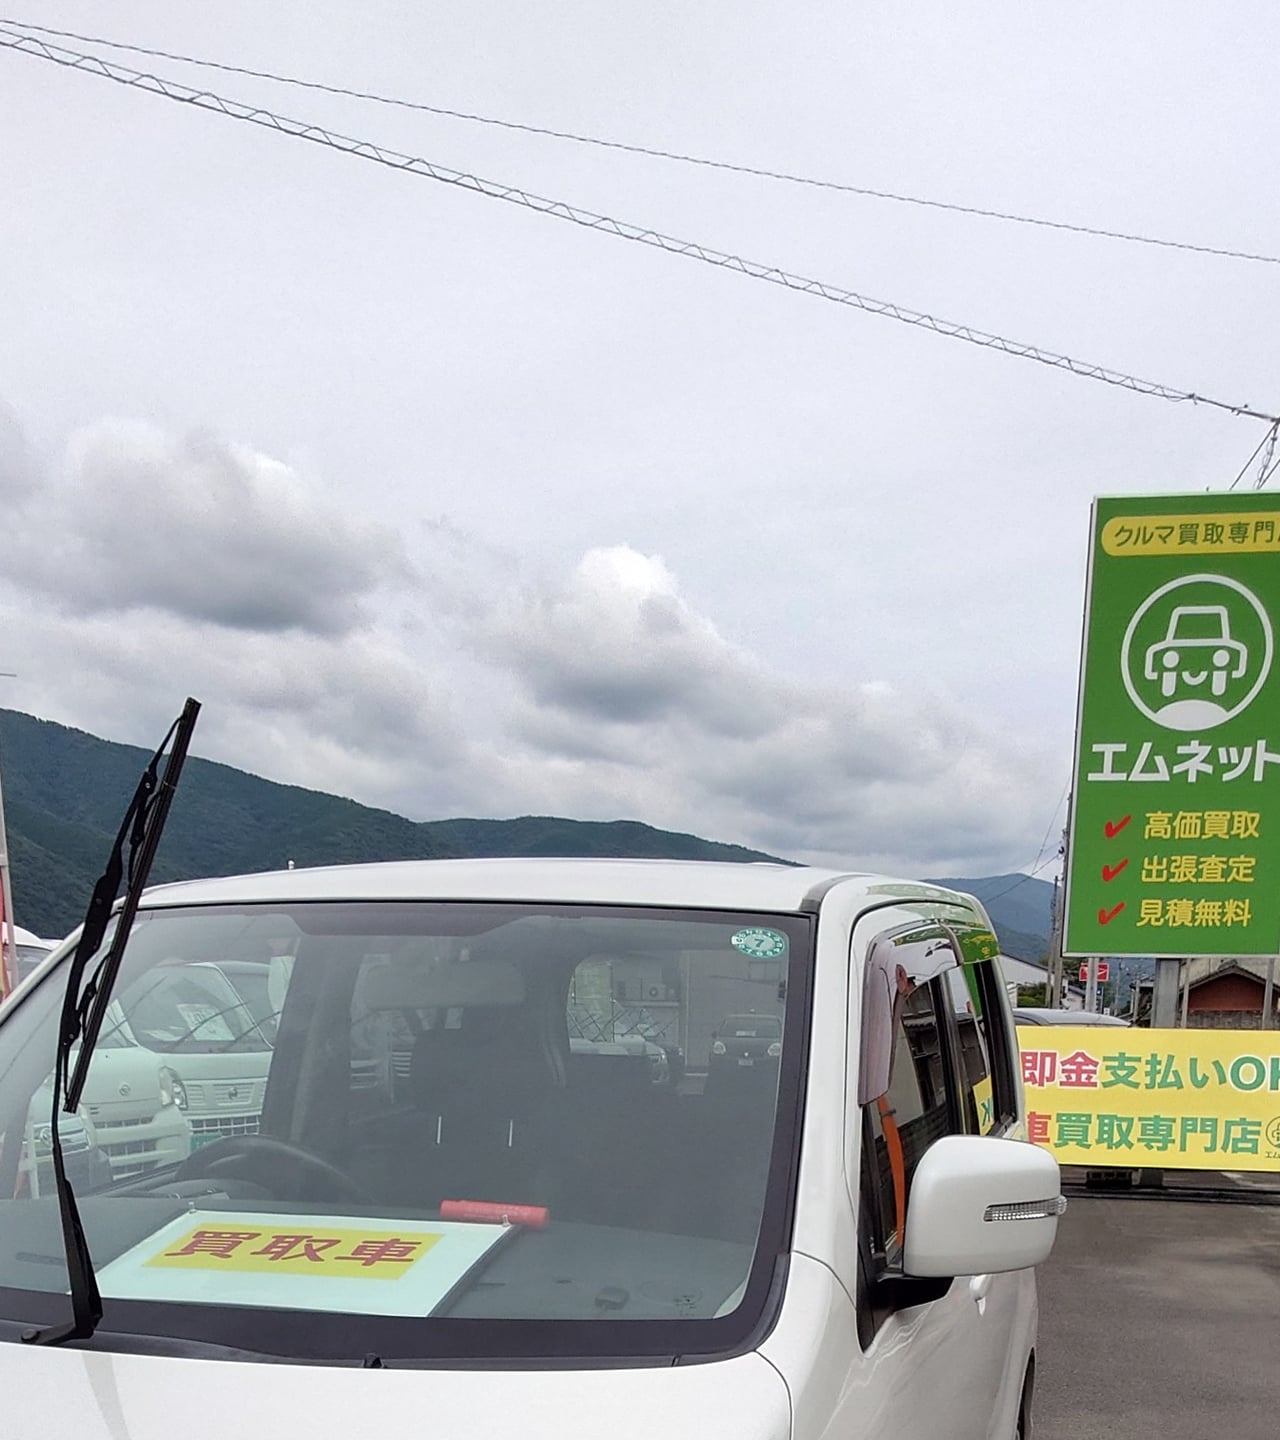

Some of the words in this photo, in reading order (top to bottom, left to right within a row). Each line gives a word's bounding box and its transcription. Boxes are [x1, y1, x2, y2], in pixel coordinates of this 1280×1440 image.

[1143, 810, 1261, 840] 高価買取
[1140, 854, 1257, 884] 出張査定
[1135, 898, 1252, 929] 見積無料
[164, 1229, 423, 1267] 買取車
